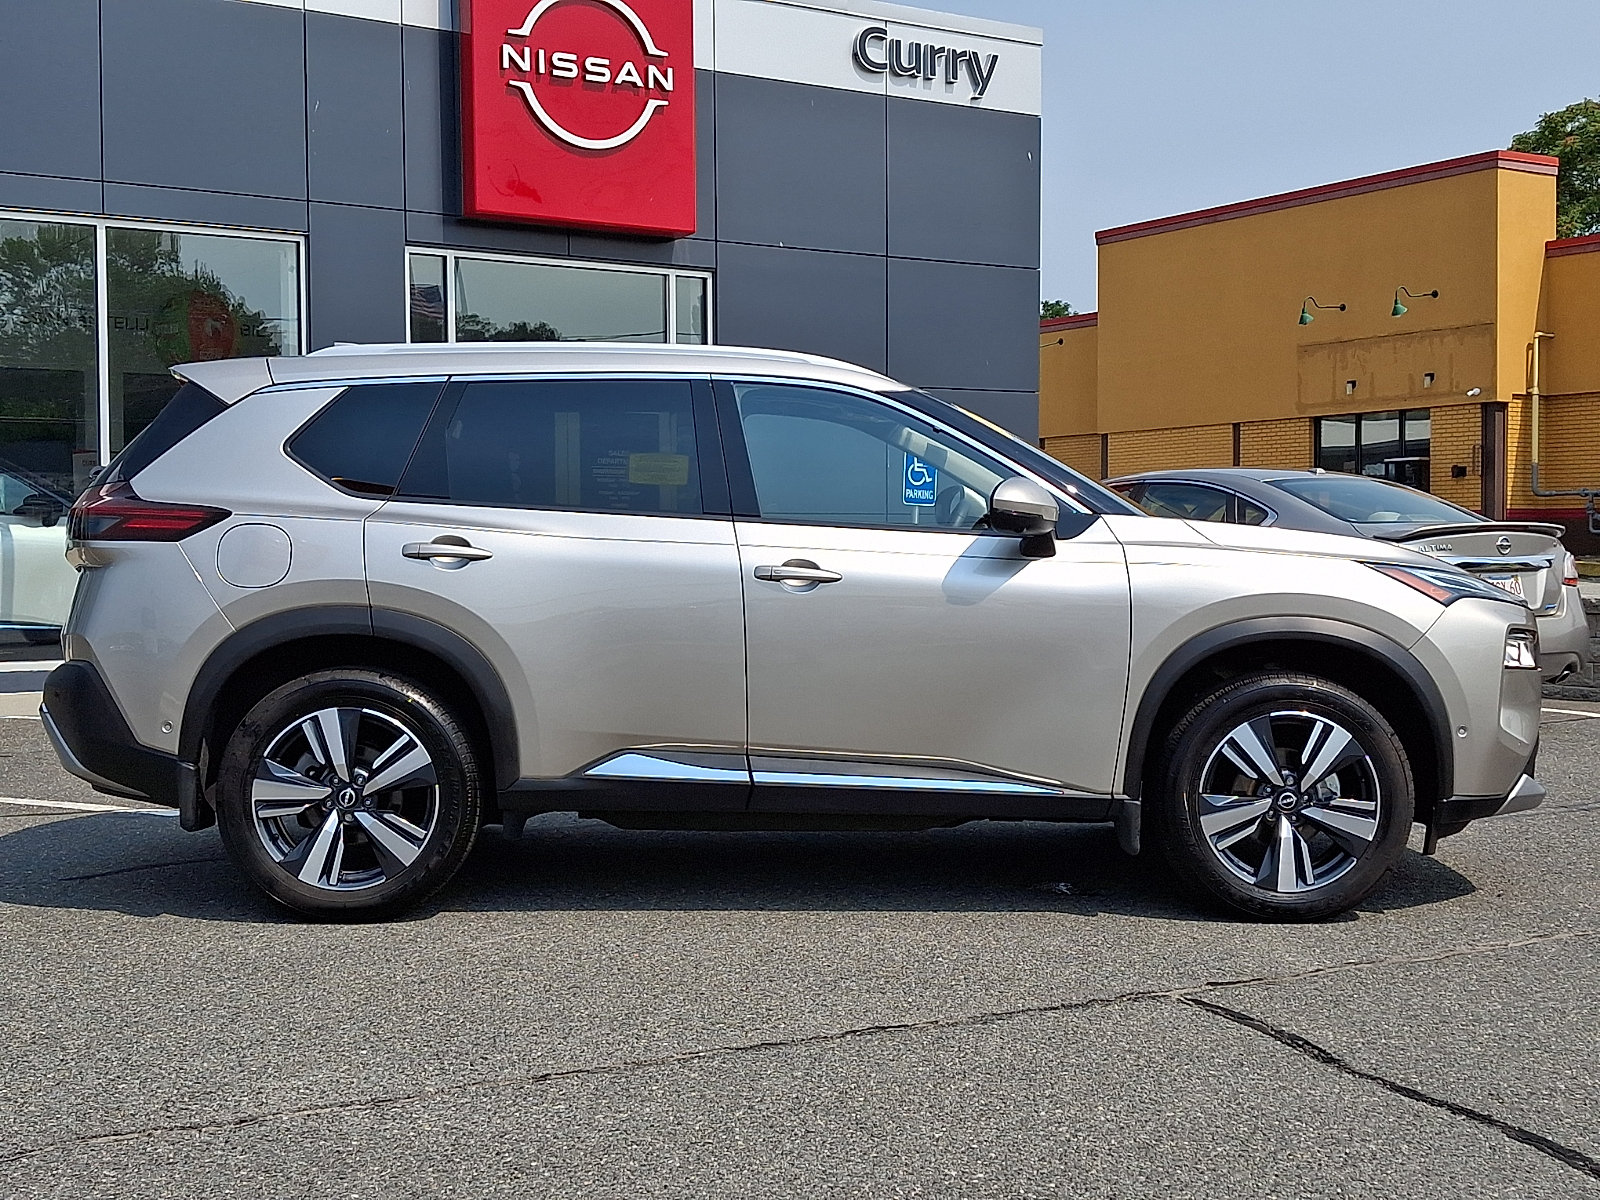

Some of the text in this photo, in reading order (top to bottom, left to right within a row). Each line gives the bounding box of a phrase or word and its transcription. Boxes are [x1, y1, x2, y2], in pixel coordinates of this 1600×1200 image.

[502, 43, 674, 91] NISSAN
[854, 26, 999, 99] Curry
[905, 489, 933, 499] PARKING
[1419, 544, 1452, 552] ALTIMA
